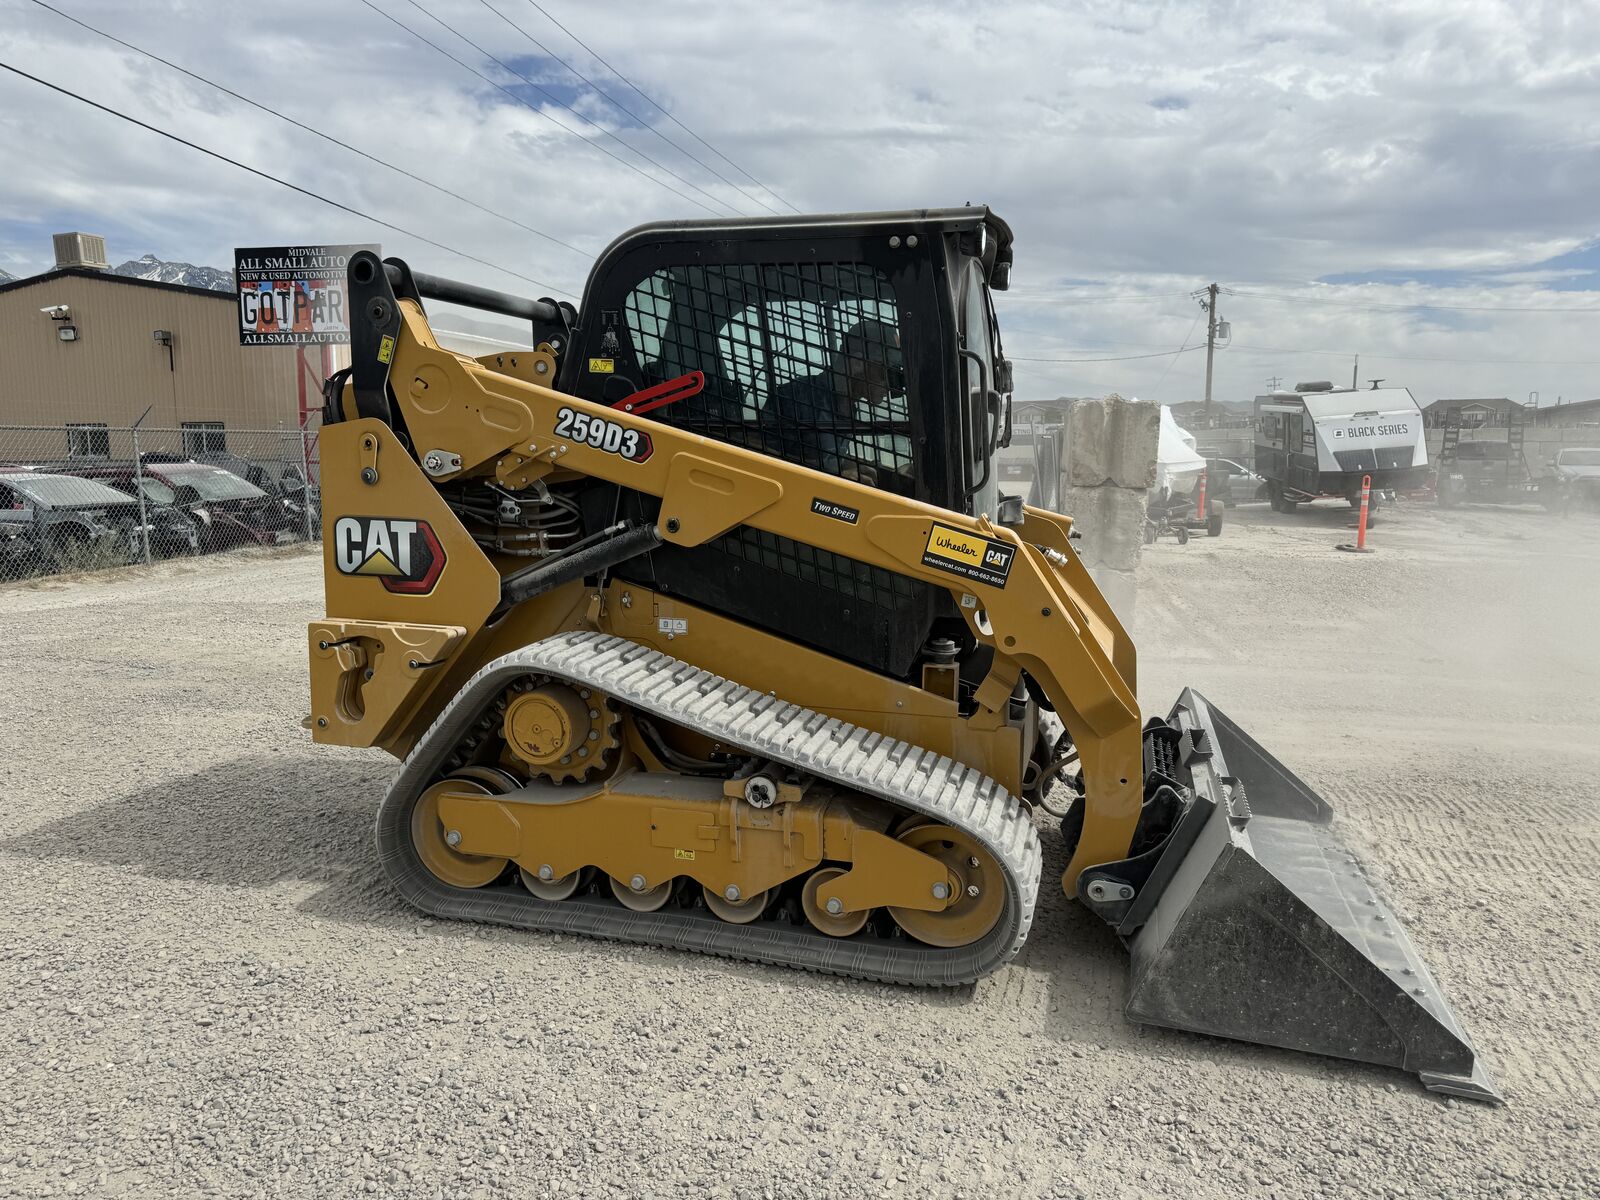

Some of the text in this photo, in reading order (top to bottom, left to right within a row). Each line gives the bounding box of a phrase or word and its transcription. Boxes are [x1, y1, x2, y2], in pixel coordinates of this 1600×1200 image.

[288, 247, 326, 257] MIDVALE
[239, 255, 346, 270] ALL SMALL AUTO
[240, 273, 260, 281] NEW
[261, 272, 268, 280] &
[269, 271, 291, 280] USED
[244, 333, 351, 344] ALLSMALLAUTO.
[555, 408, 639, 458] 259D3
[1348, 423, 1408, 438] BLACK SERIES
[336, 517, 417, 576] CAT
[936, 536, 978, 557] Wheeler
[985, 549, 1009, 567] CAT
[924, 556, 1005, 585] wheelercat.com 800-662-8650
